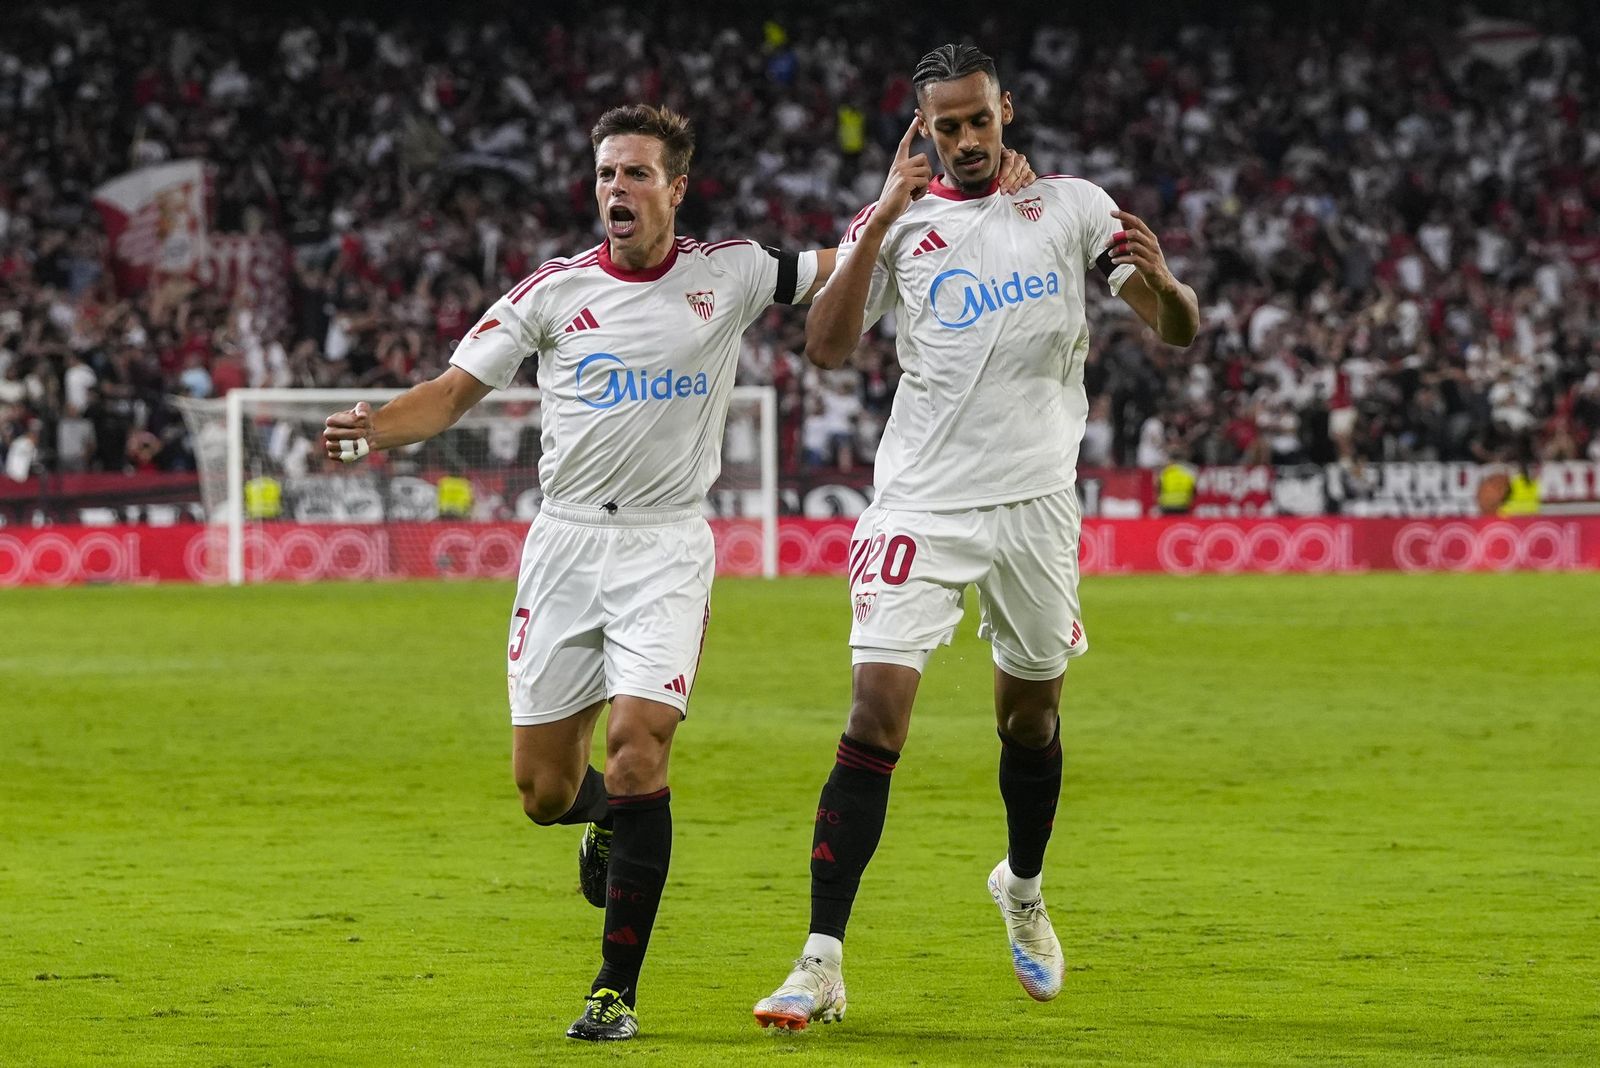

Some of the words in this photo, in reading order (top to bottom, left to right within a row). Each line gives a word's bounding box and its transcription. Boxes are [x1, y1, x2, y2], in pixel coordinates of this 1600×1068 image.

[956, 270, 1060, 321] Midea
[598, 368, 708, 403] Midea
[0, 532, 160, 585] OOOL
[1157, 522, 1369, 574] GOOOL
[1392, 521, 1598, 573] GOOOL
[509, 607, 530, 661] 3
[815, 807, 841, 825] FC
